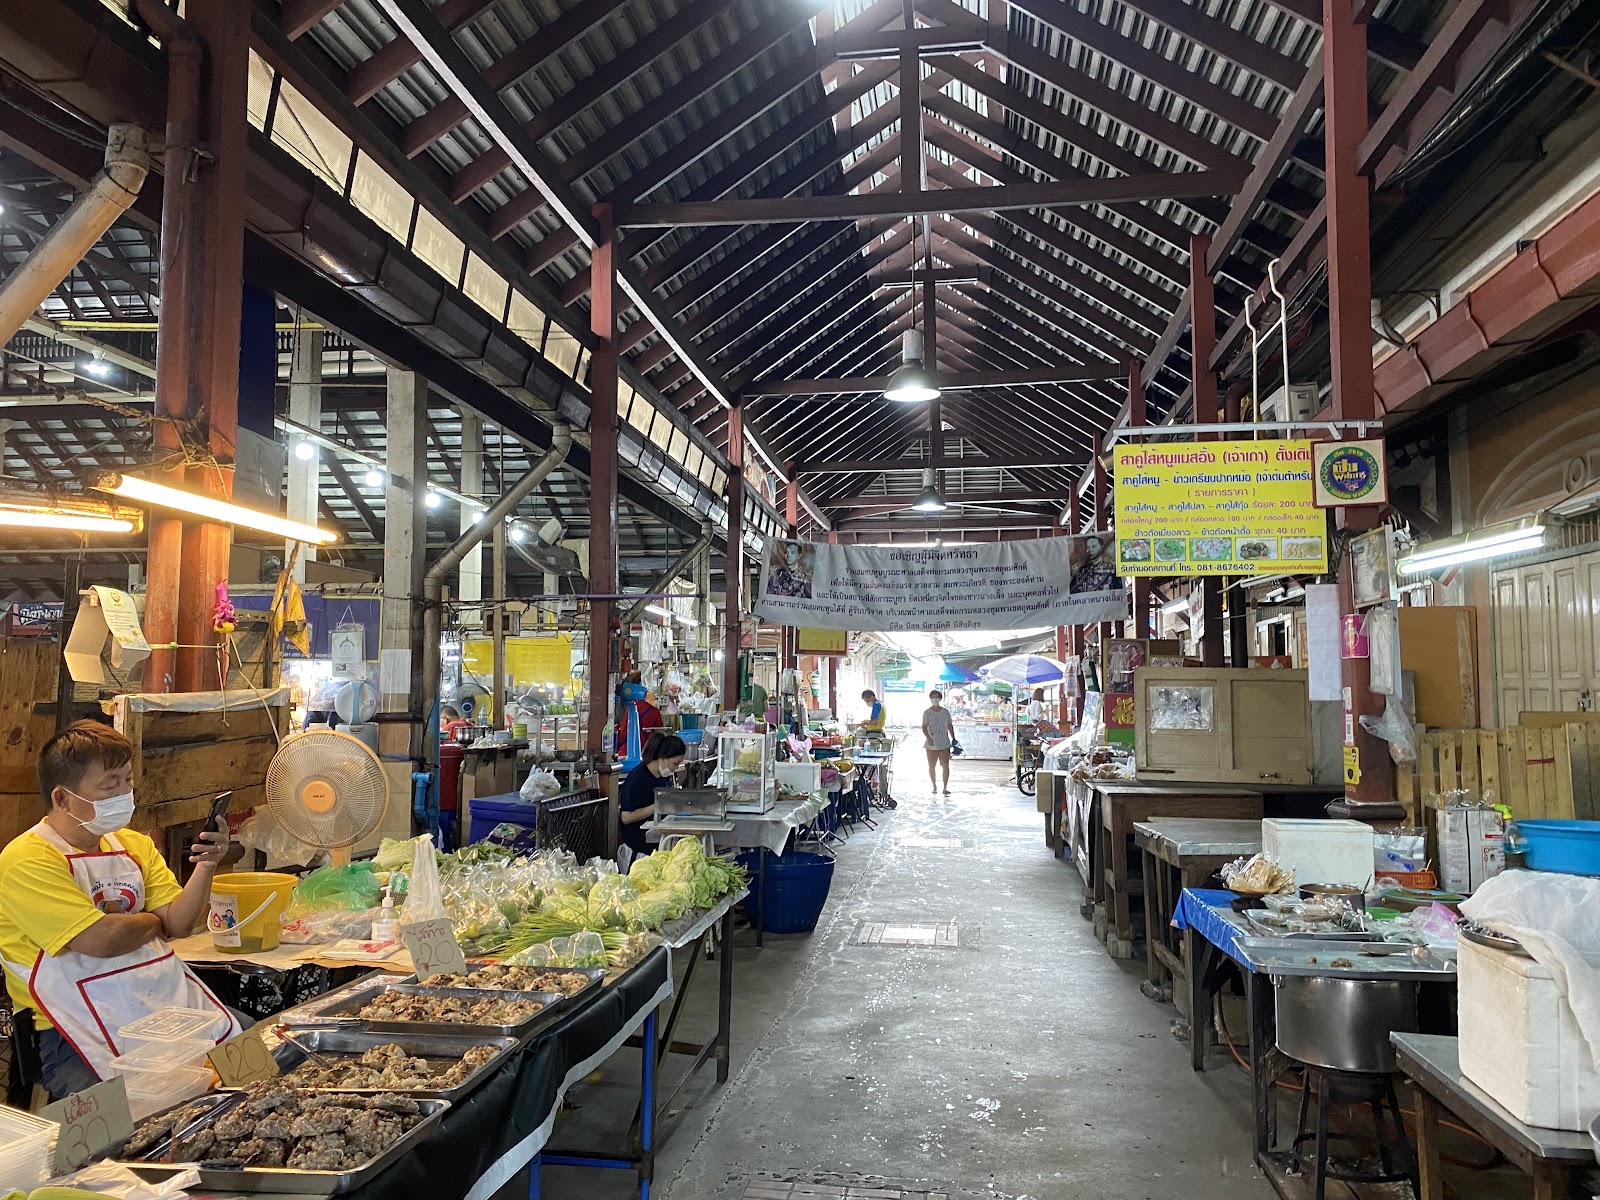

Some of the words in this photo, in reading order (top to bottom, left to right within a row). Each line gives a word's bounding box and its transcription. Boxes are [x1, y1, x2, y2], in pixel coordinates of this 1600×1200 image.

[1120, 446, 1216, 468] สาคูไส้หมูแม่สอิ้ง
[1223, 445, 1269, 464] (เจ้าเก่า)
[1121, 471, 1160, 488] สาคูไส้หมู
[1173, 470, 1251, 484] ข้าวเกรียบปากหม้อ
[1195, 489, 1248, 497] รายการราคา
[1124, 502, 1158, 513] สาคูไส้หมู
[1168, 501, 1205, 513] สาคูไส้ปลา
[1215, 500, 1249, 512] สาคูไส้กุ้ง
[1279, 500, 1296, 508] 200
[1121, 516, 1152, 525] กล่องใหญ่
[1190, 515, 1225, 523] กล่องกลาง
[889, 547, 978, 564] ขอเชิญผู้มีจิตศรัทธา
[1120, 562, 1176, 573] รับทำนอกสถานที่
[1179, 562, 1194, 572] โทร.
[1197, 563, 1255, 572] 081-8676402
[830, 579, 912, 589] เพื่อให้มีความมั่นคงแข็งแรง
[915, 581, 941, 589] สวยงาม
[943, 578, 987, 588] สมพระเกียรติ
[990, 575, 1045, 586] ของพระองค์ท่าน
[761, 599, 846, 615] ท่านสามารถร่วมสมทบทุนได้ที่
[848, 604, 883, 617] ตู้รับบริจาค
[1053, 591, 1123, 609] (ภายในตลาดนางเลิ้ง)
[816, 590, 906, 604] และให้เป็นสถานที่สักการะบูชา
[908, 588, 1004, 602] ยึดเหนี่ยวจิตใจของชาวนางเลิ้ง
[1007, 587, 1059, 601] และบุคคลทั่วไป
[889, 621, 903, 630] มีศีล
[905, 621, 920, 630] มีสุข
[922, 621, 951, 630] มีสามัคคี
[953, 621, 982, 631] มีสันติสุข
[419, 940, 454, 967] 20
[224, 1036, 273, 1083] 20
[66, 1115, 111, 1171] 30
